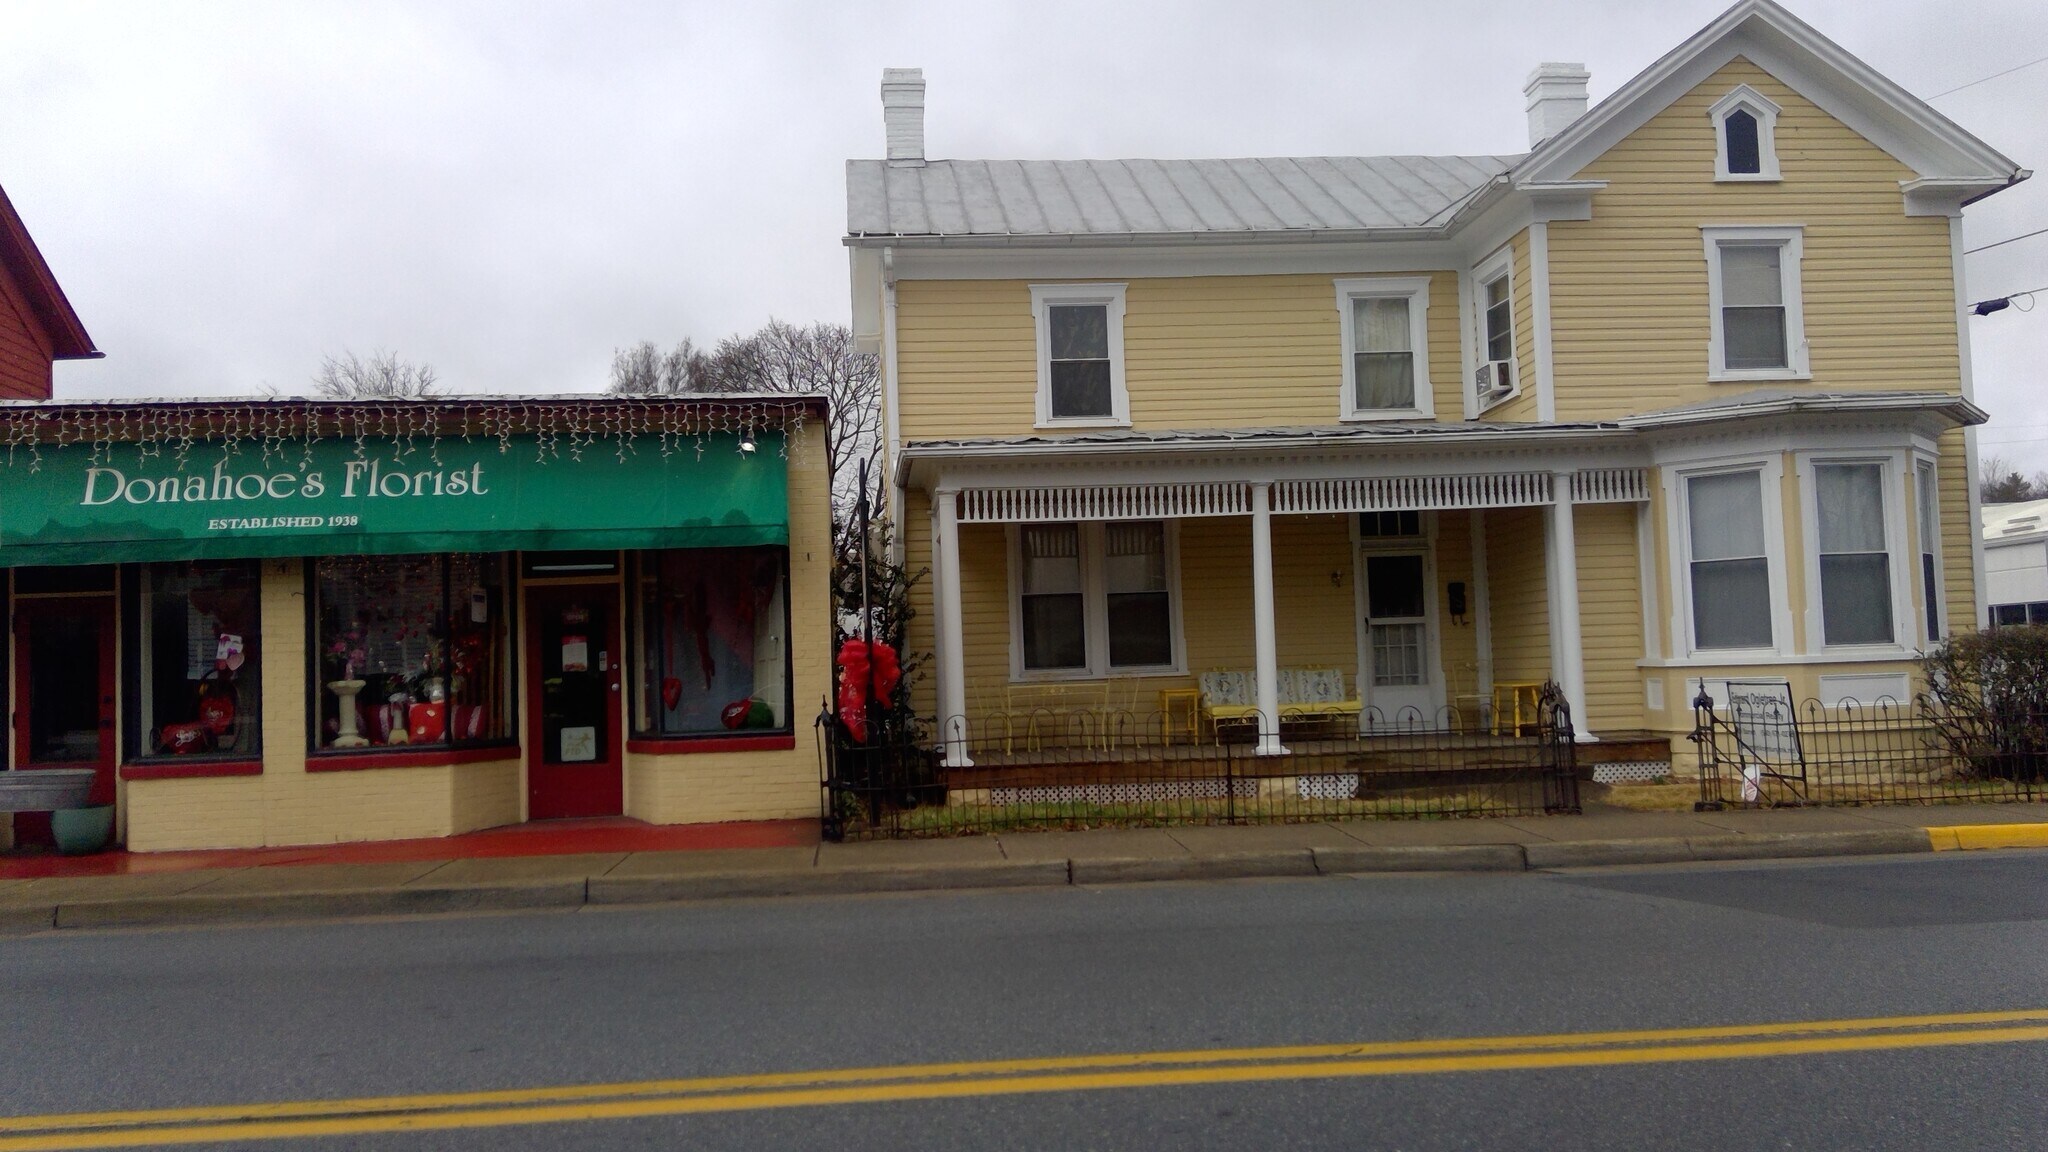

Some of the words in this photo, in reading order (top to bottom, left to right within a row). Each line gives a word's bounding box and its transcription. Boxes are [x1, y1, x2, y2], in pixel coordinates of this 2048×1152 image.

[80, 459, 325, 506] Donahoe's
[340, 458, 489, 498] Florist
[208, 517, 324, 530] ESTABLISHED
[328, 515, 358, 527] 1938
